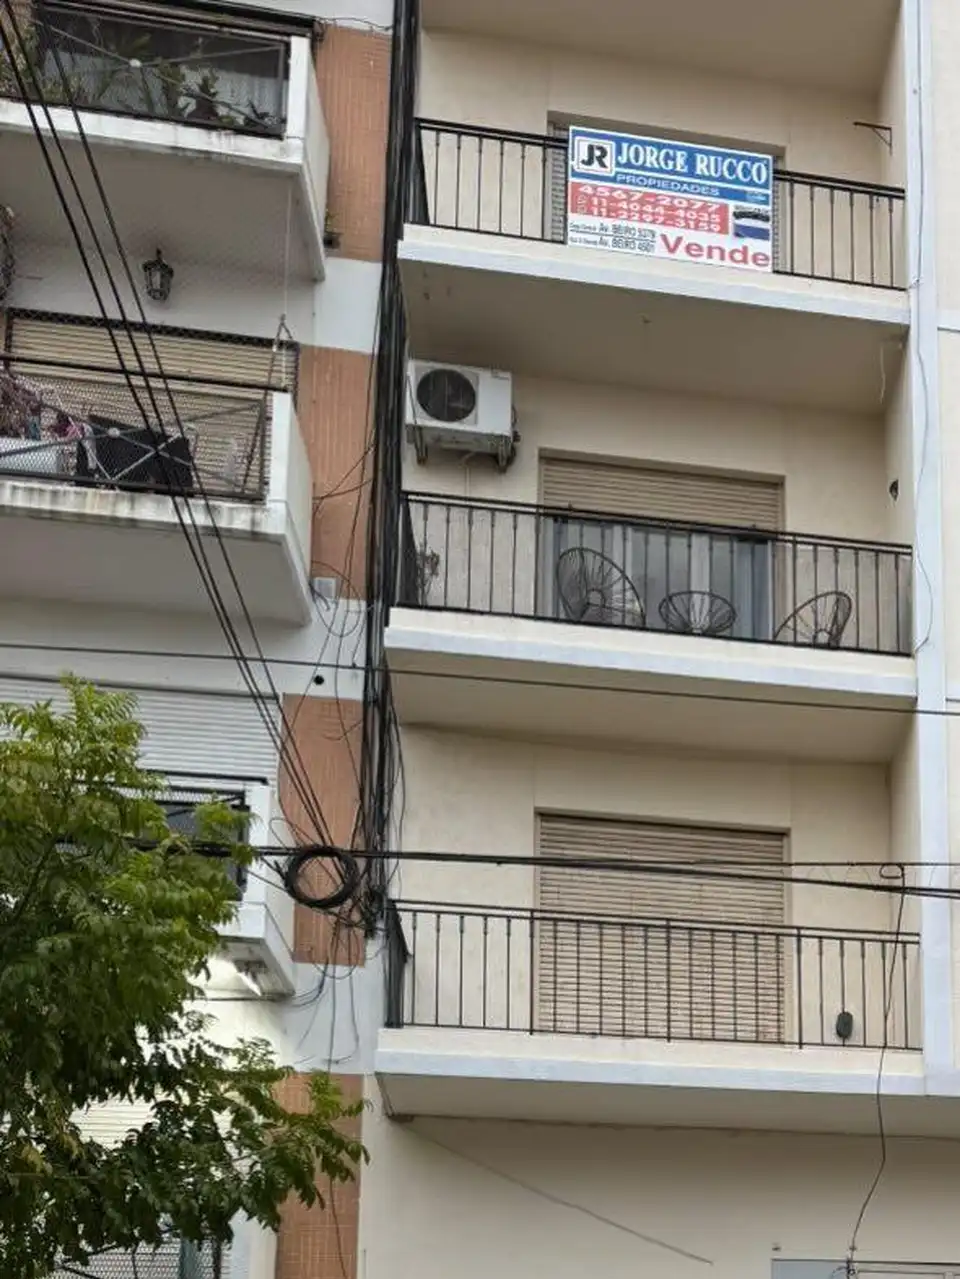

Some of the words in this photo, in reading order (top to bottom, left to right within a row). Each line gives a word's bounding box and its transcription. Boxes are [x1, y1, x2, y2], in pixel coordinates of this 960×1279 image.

[581, 144, 608, 169] JR
[617, 142, 688, 173] JORGE
[695, 153, 768, 184] RUCCO
[579, 184, 721, 210] 4567-2077
[616, 174, 720, 196] PROPIEDADES
[660, 233, 770, 268] Vende
